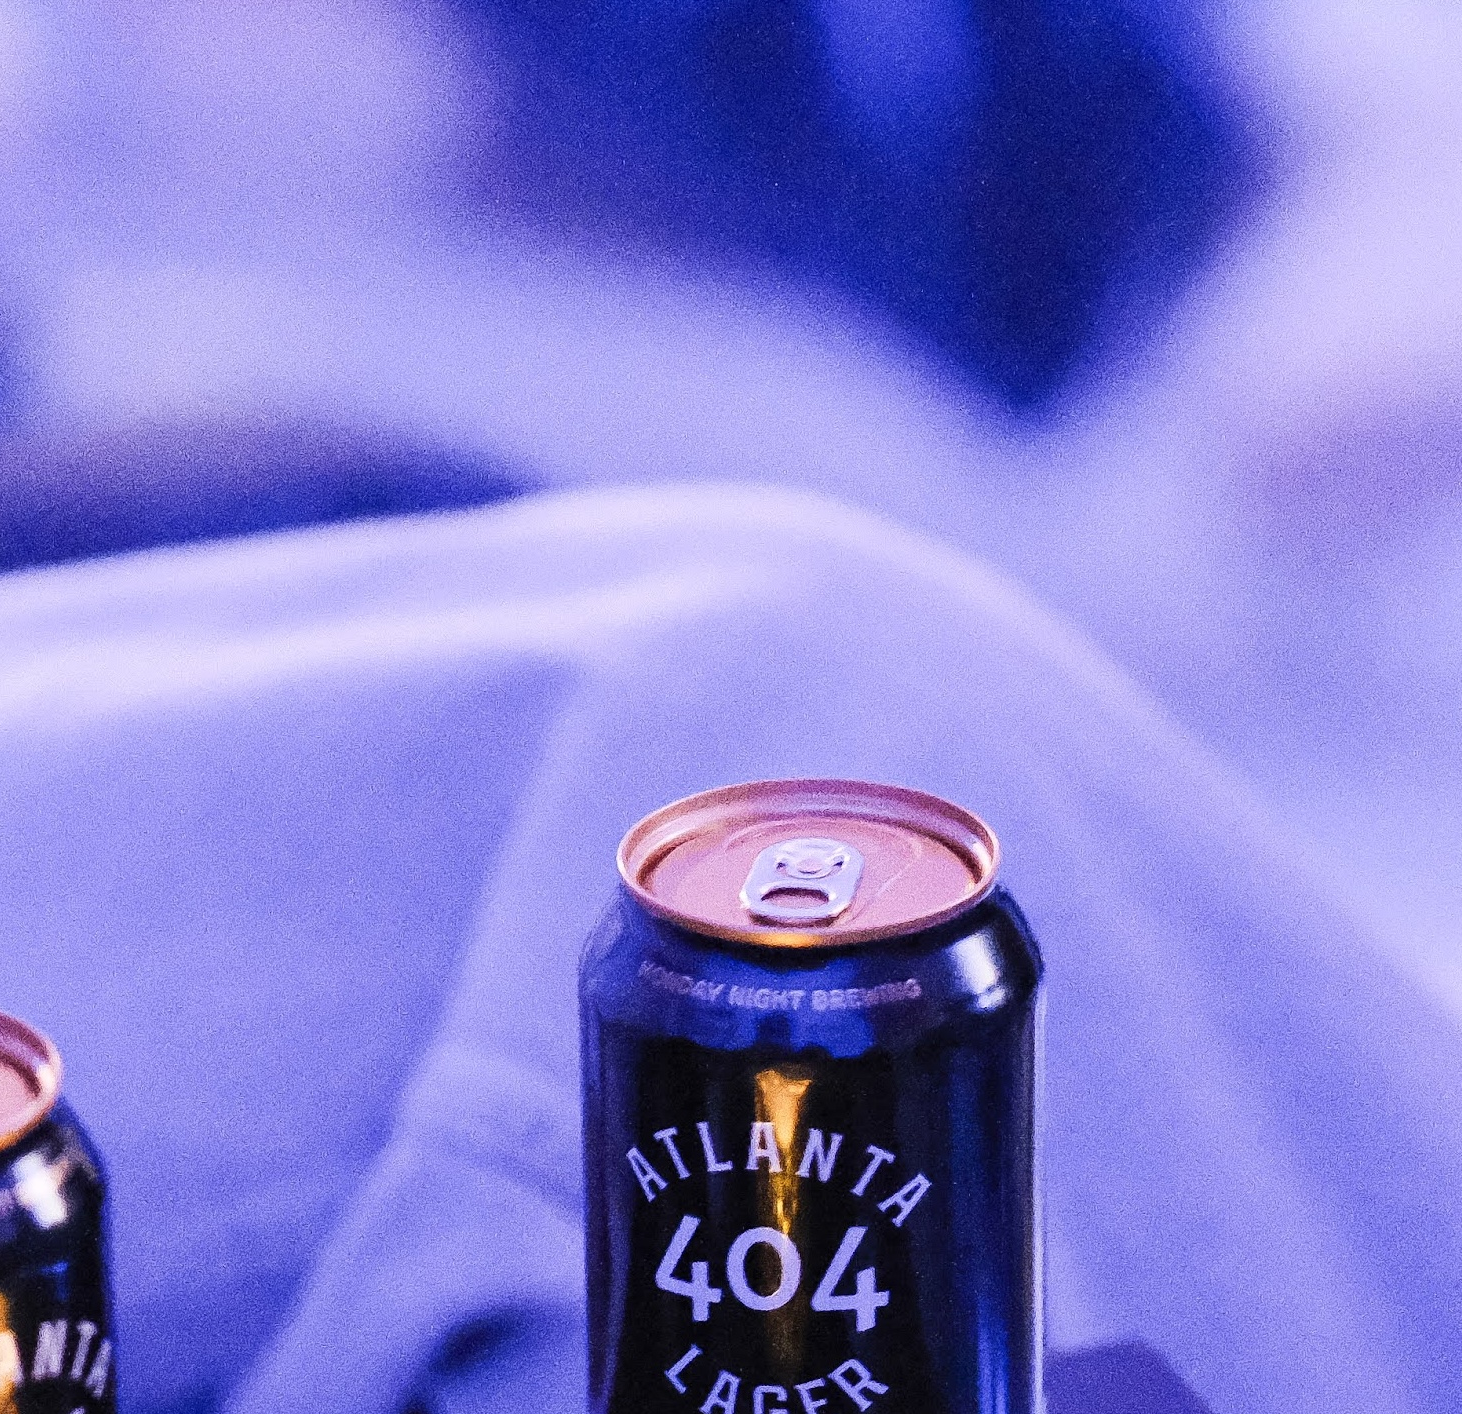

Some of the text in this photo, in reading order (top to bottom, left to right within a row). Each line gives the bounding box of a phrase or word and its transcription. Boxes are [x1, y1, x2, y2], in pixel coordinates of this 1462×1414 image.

[728, 984, 803, 1010] NIGHT
[625, 1121, 932, 1228] ATLANTA
[655, 1213, 890, 1332] 404
